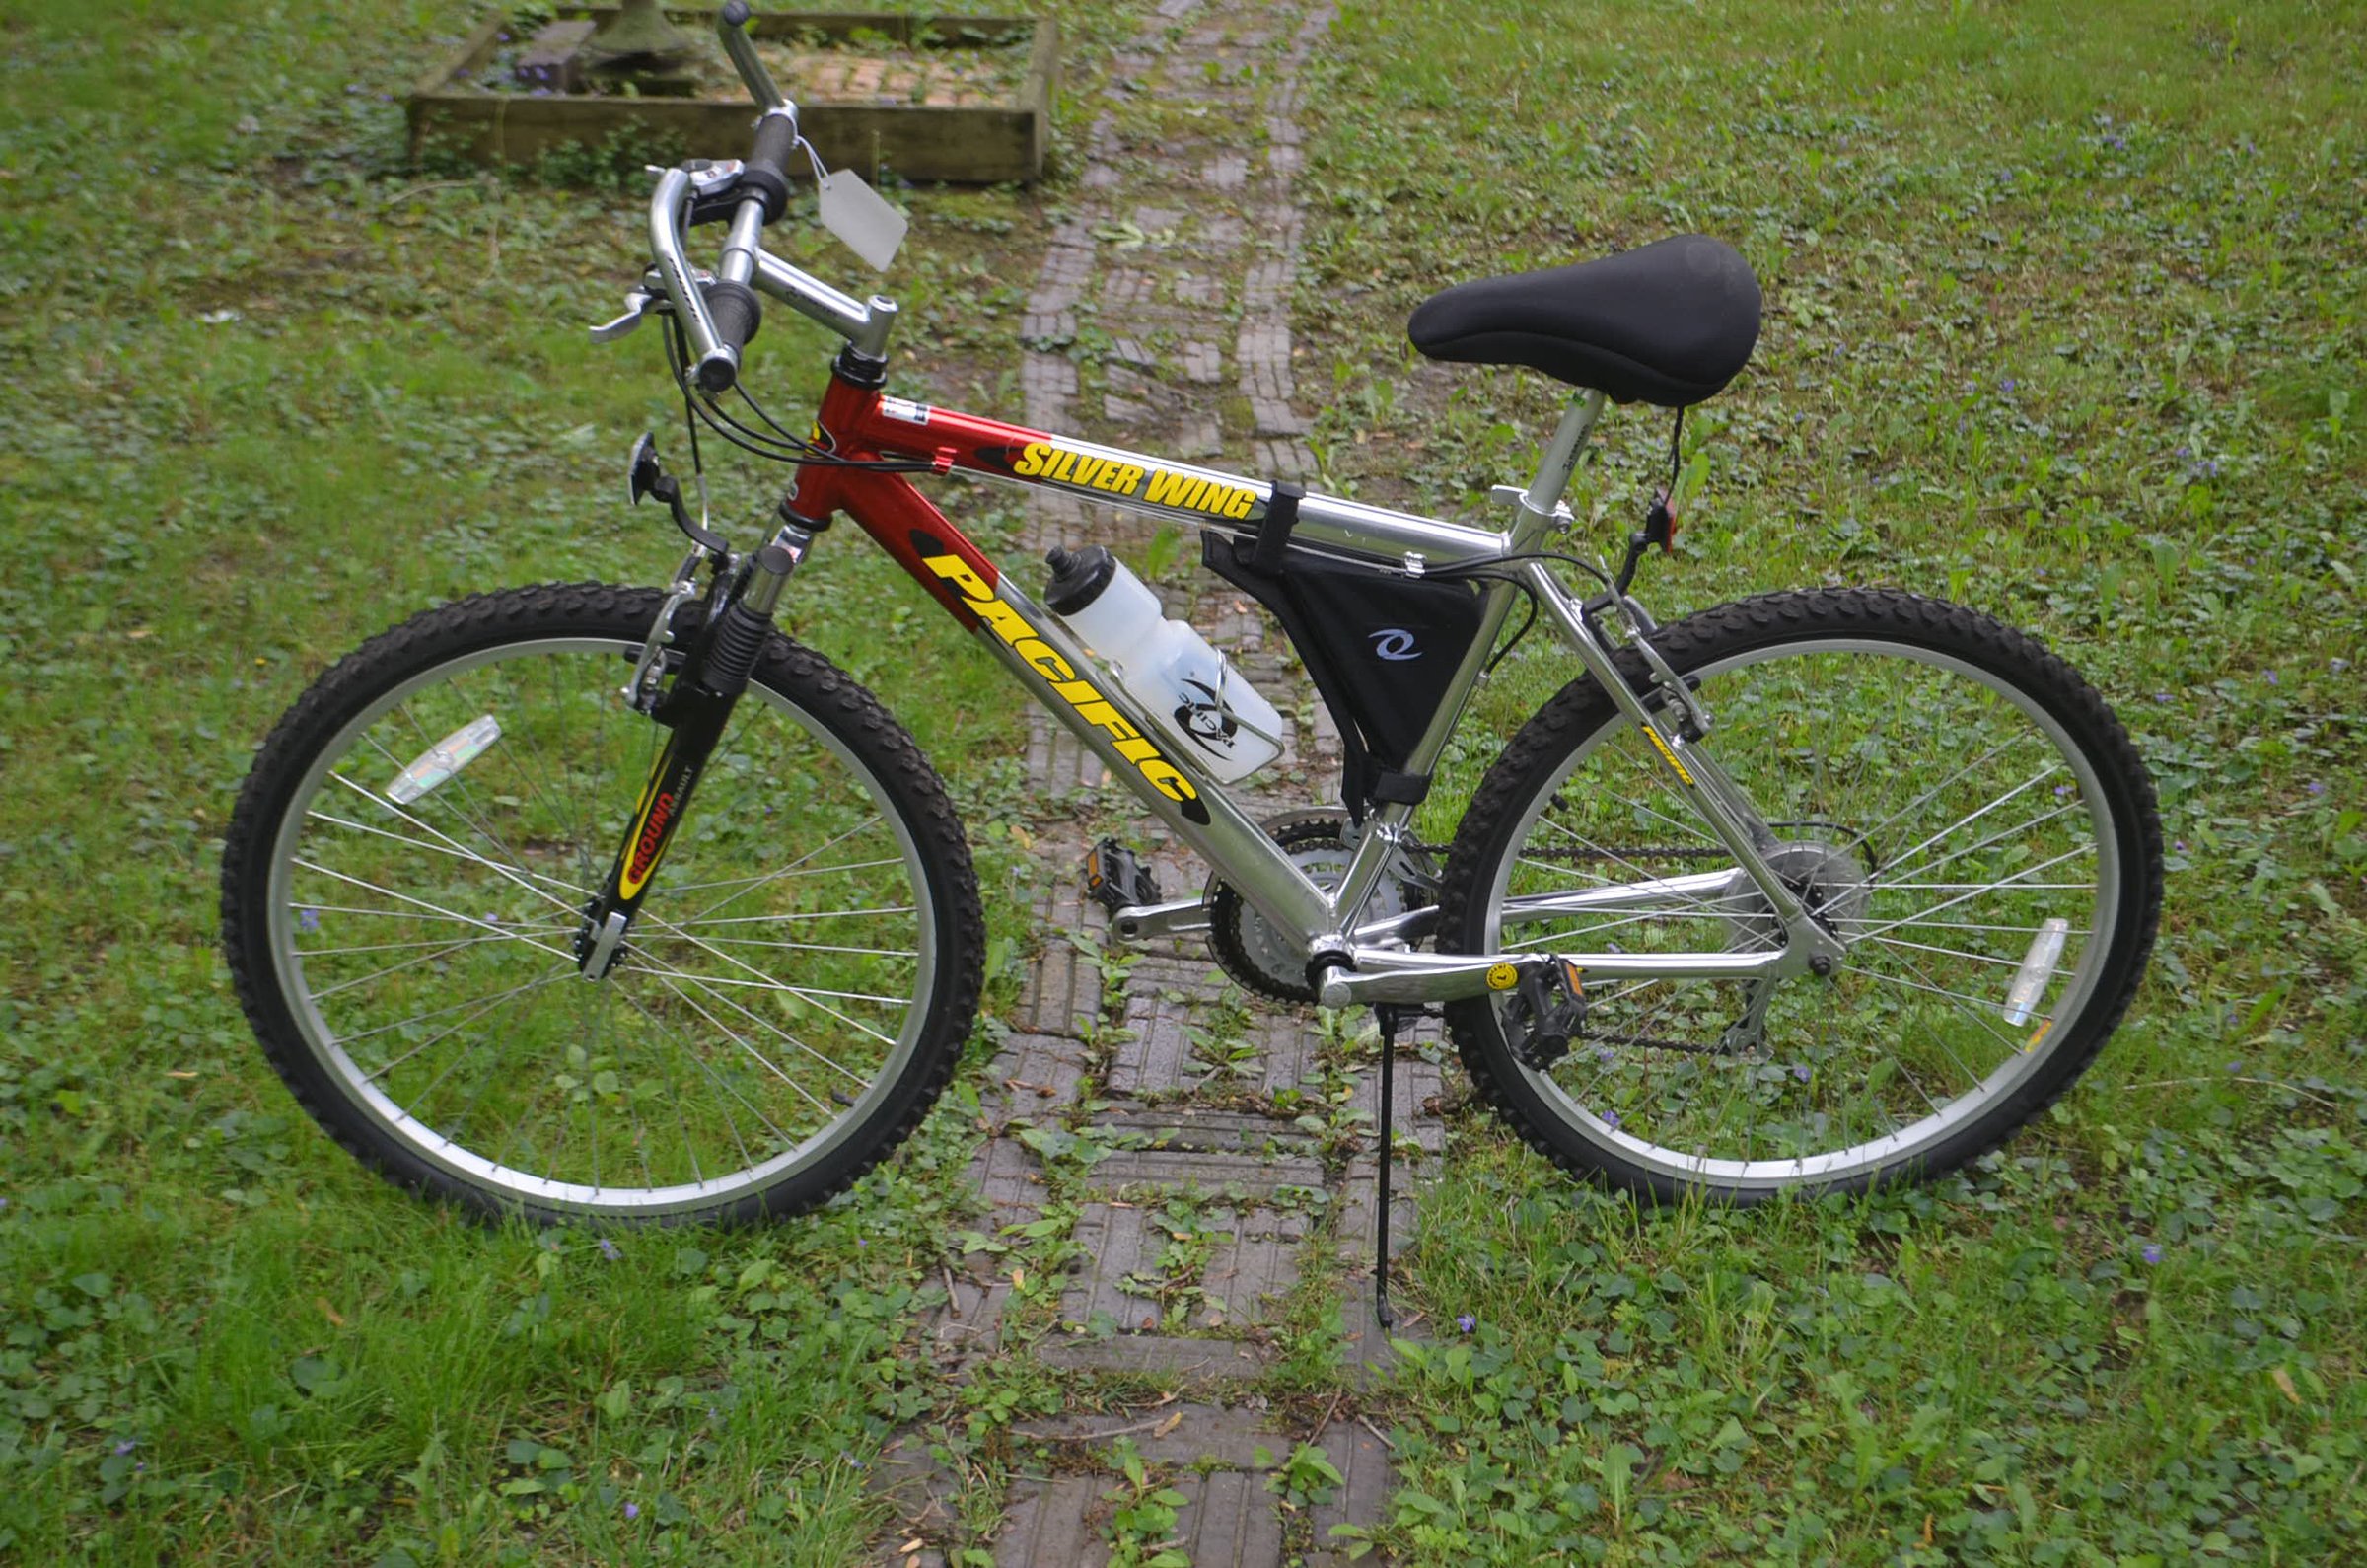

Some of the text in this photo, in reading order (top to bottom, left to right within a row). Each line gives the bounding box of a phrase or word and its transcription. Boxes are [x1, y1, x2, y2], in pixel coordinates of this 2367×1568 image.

[1014, 442, 1258, 521] SILVER WING
[922, 554, 1198, 803] PACIFIC
[1179, 692, 1236, 748] PACIFIC
[1642, 725, 1694, 785] PACIFIC
[627, 792, 674, 884] GROUND
